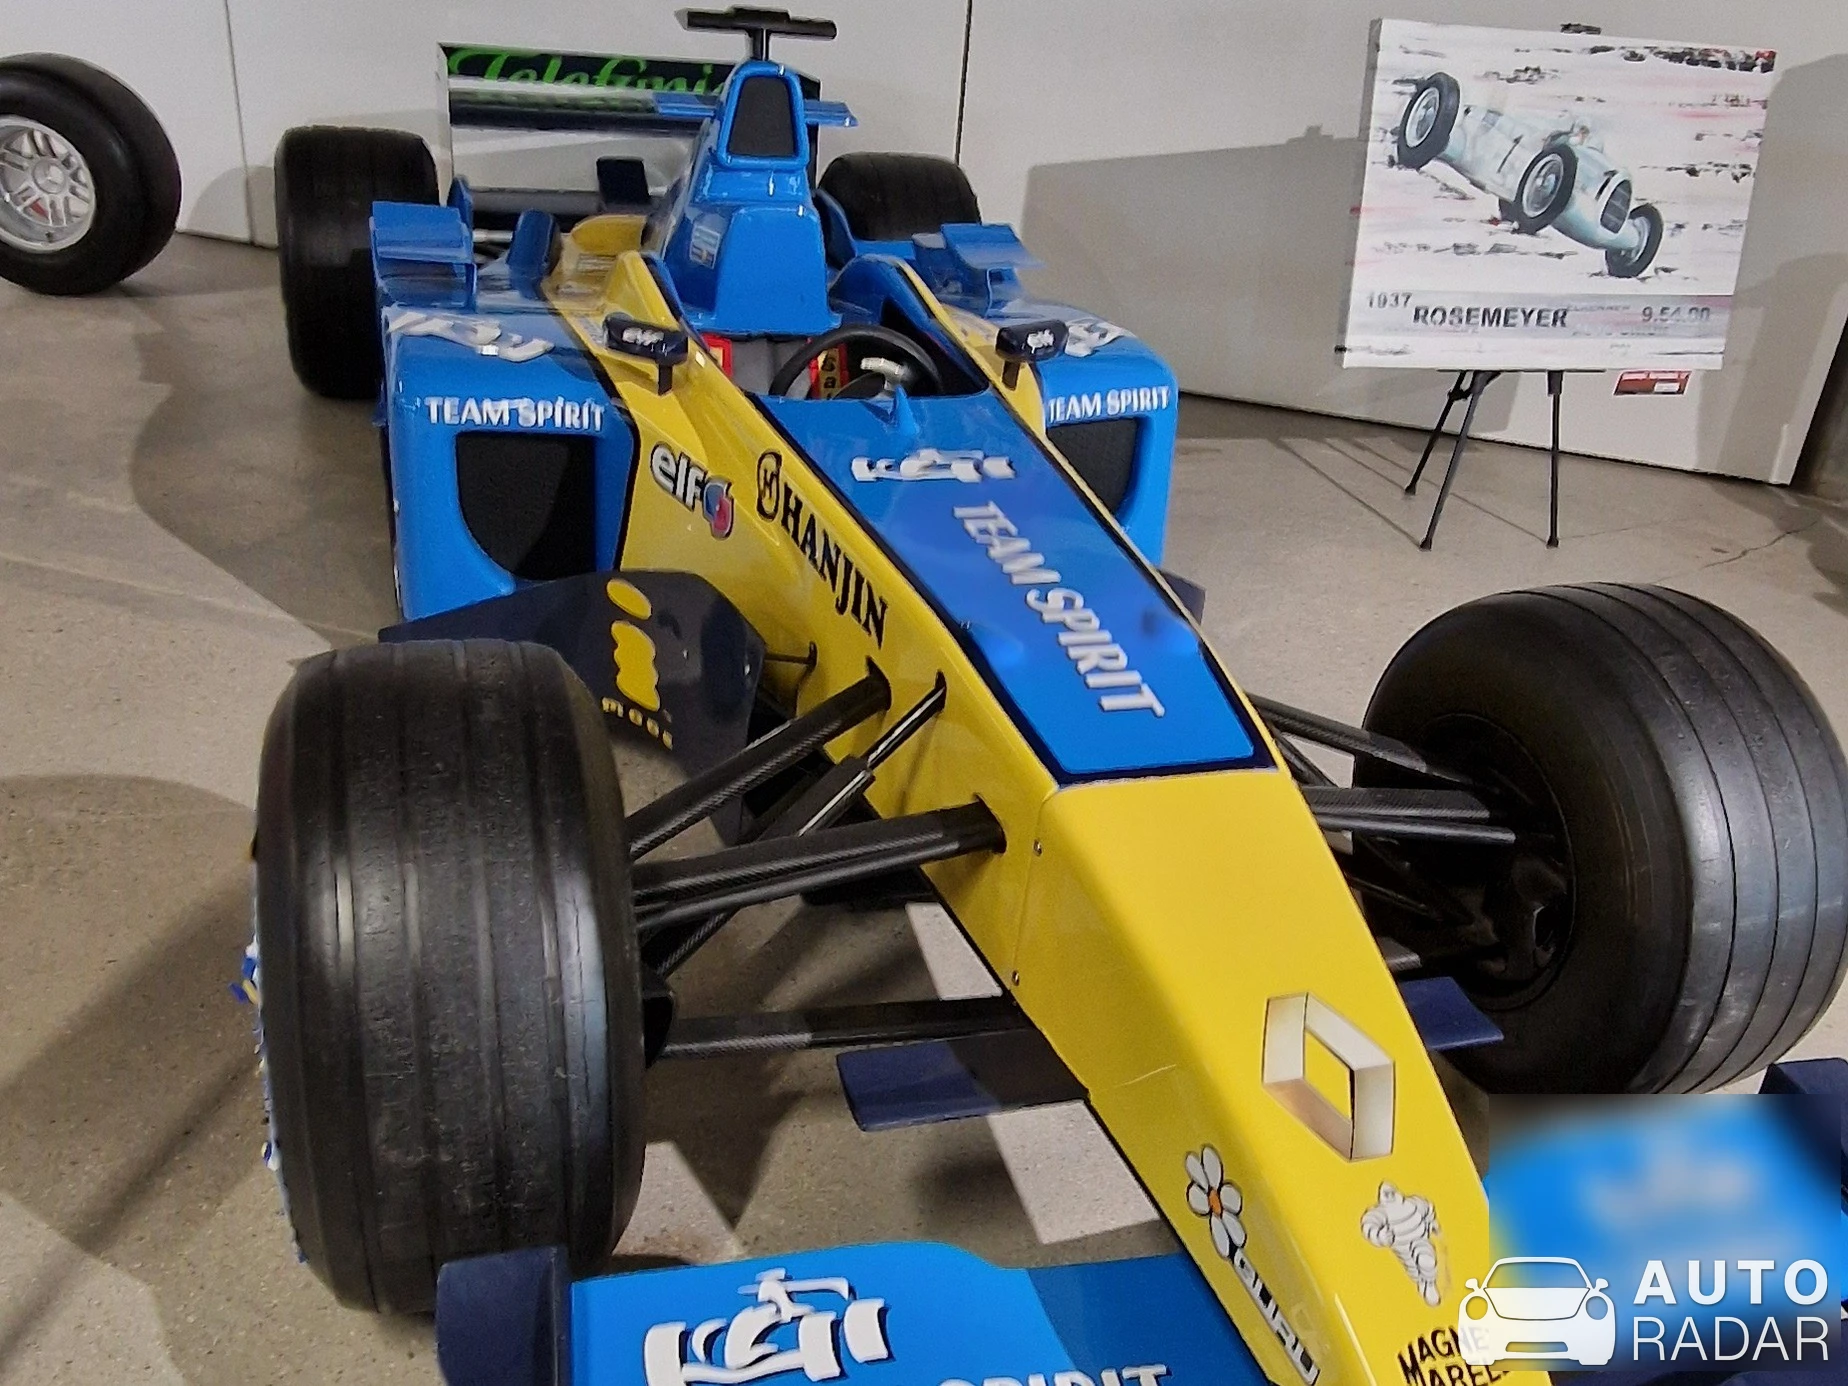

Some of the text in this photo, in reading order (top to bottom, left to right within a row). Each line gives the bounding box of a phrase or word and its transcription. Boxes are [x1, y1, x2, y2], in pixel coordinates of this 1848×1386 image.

[1412, 305, 1568, 329] ROSEMEYER
[425, 395, 606, 432] TEAM SPIRIT
[1107, 385, 1169, 416] SPIRIT
[650, 443, 709, 513] elf
[781, 482, 888, 650] HANJIN
[953, 501, 1166, 717] TEAM SPIRIT
